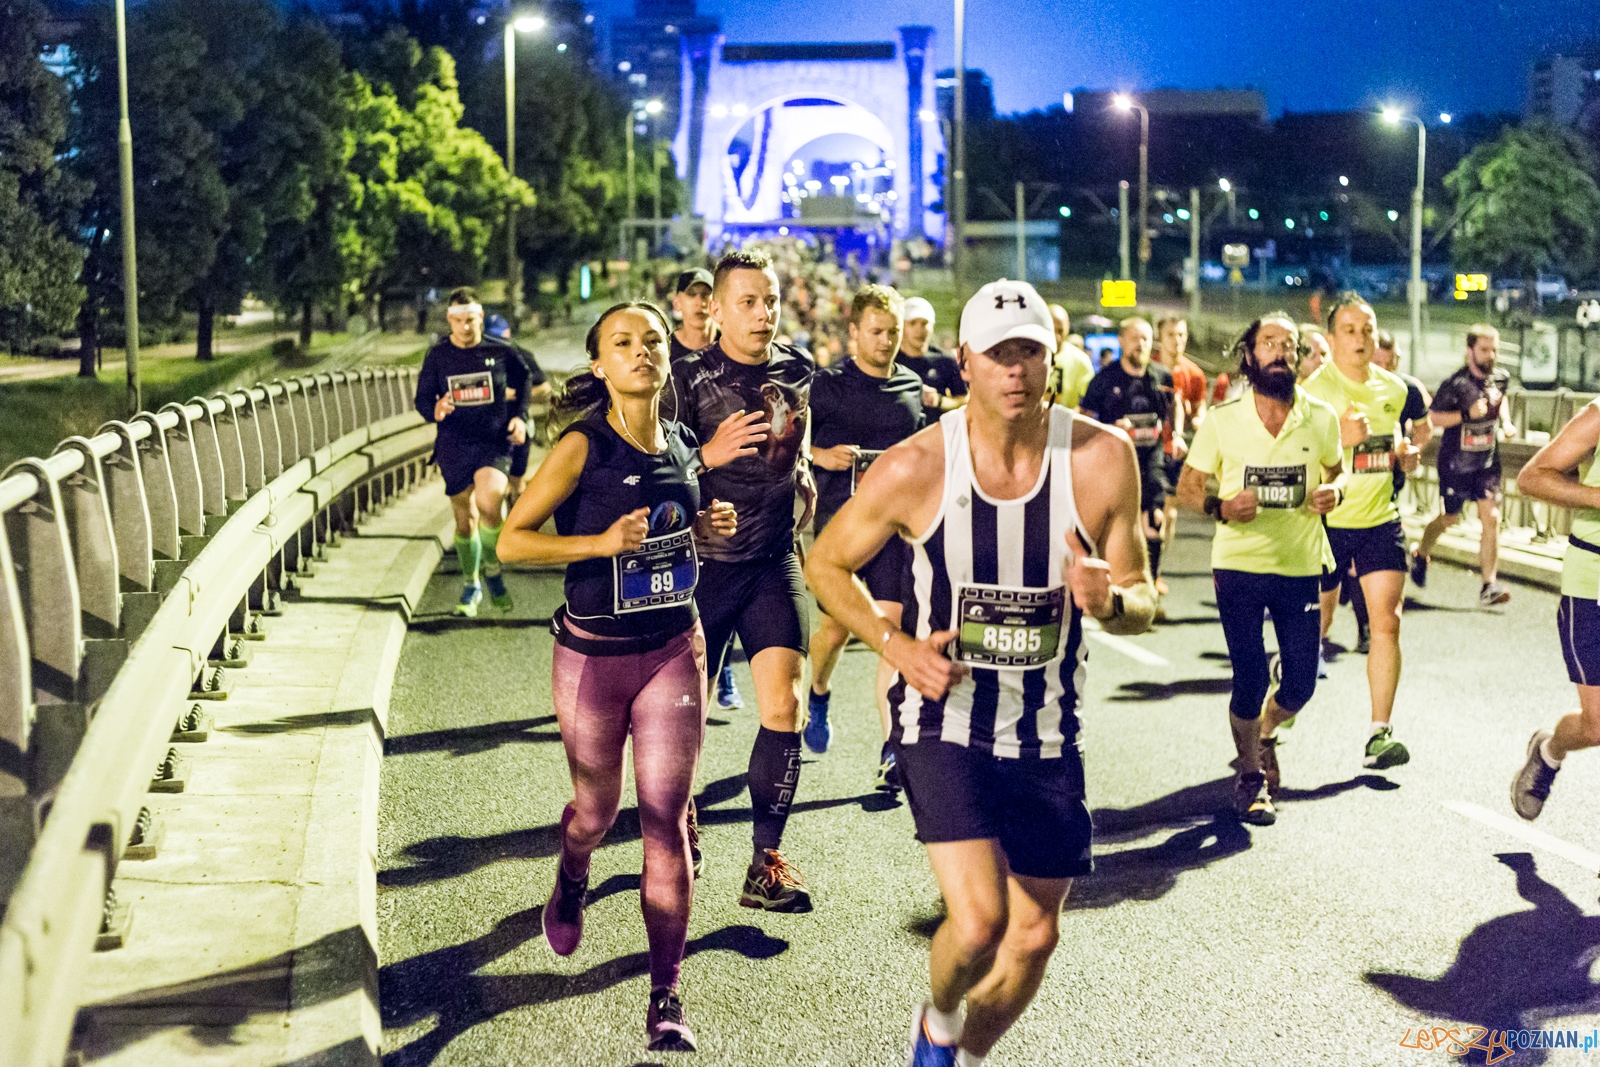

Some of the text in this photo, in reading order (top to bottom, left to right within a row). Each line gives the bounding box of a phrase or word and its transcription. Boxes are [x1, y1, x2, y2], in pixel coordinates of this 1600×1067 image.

[623, 475, 641, 485] 4F
[1257, 486, 1294, 501] 11021
[651, 571, 674, 593] 89
[983, 626, 1041, 652] 8585
